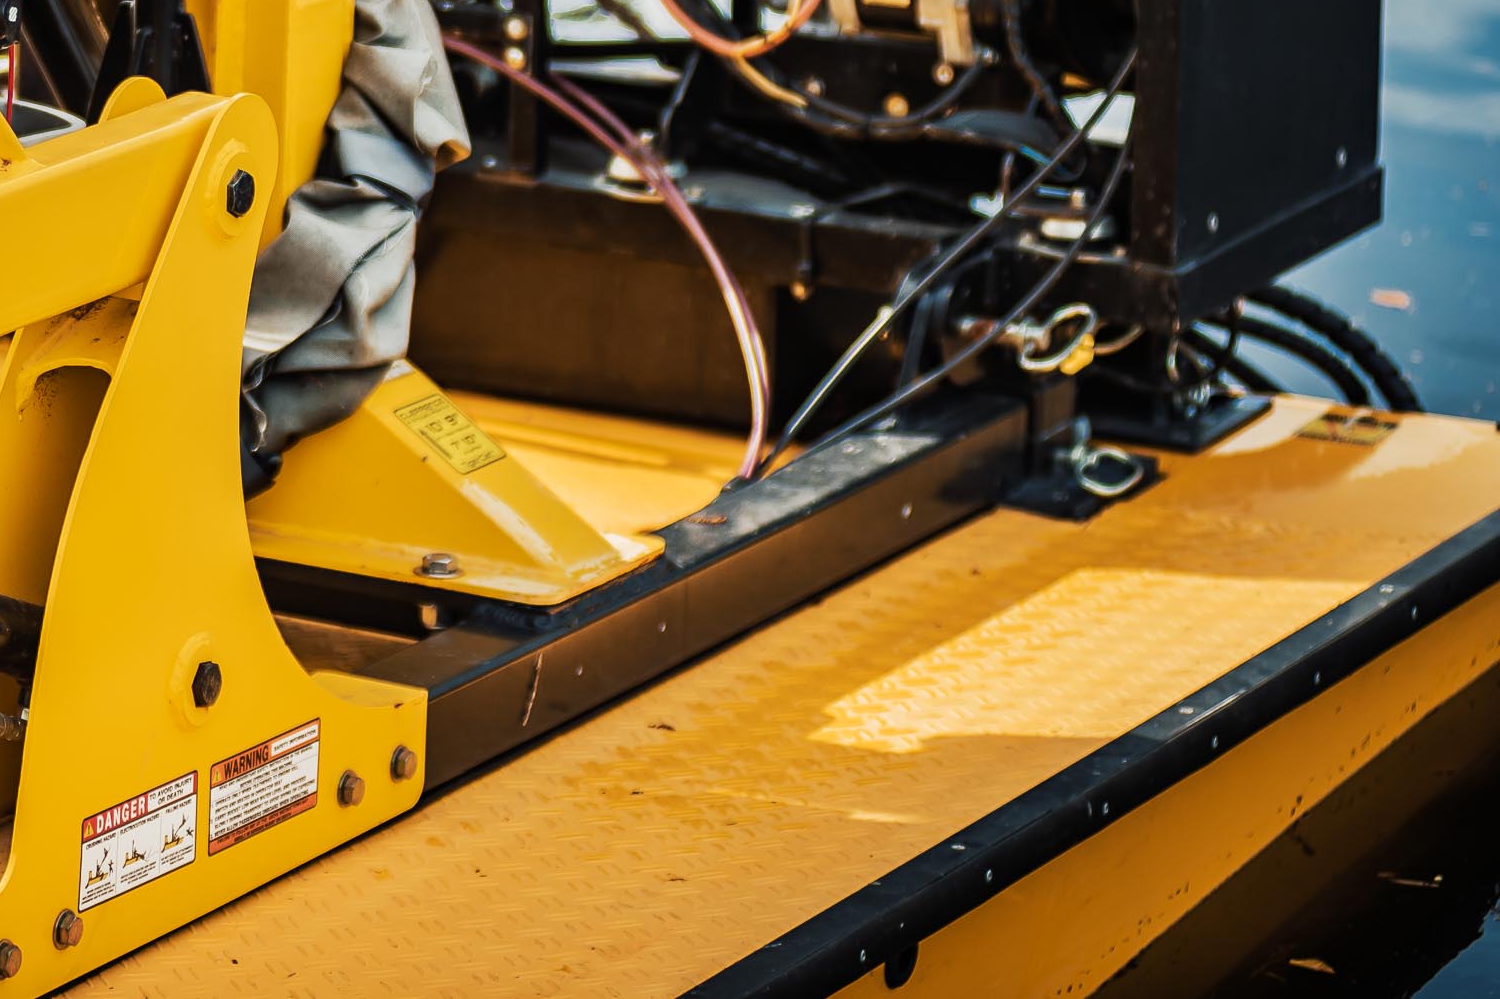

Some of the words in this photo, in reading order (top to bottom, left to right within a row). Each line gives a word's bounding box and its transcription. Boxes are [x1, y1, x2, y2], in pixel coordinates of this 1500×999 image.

[224, 745, 269, 780] WARNING
[149, 792, 156, 801] TO
[157, 785, 173, 797] AVOID
[174, 777, 192, 790] INJURY
[157, 796, 165, 805] OR
[167, 788, 183, 801] DEATH
[96, 796, 145, 834] DANGER
